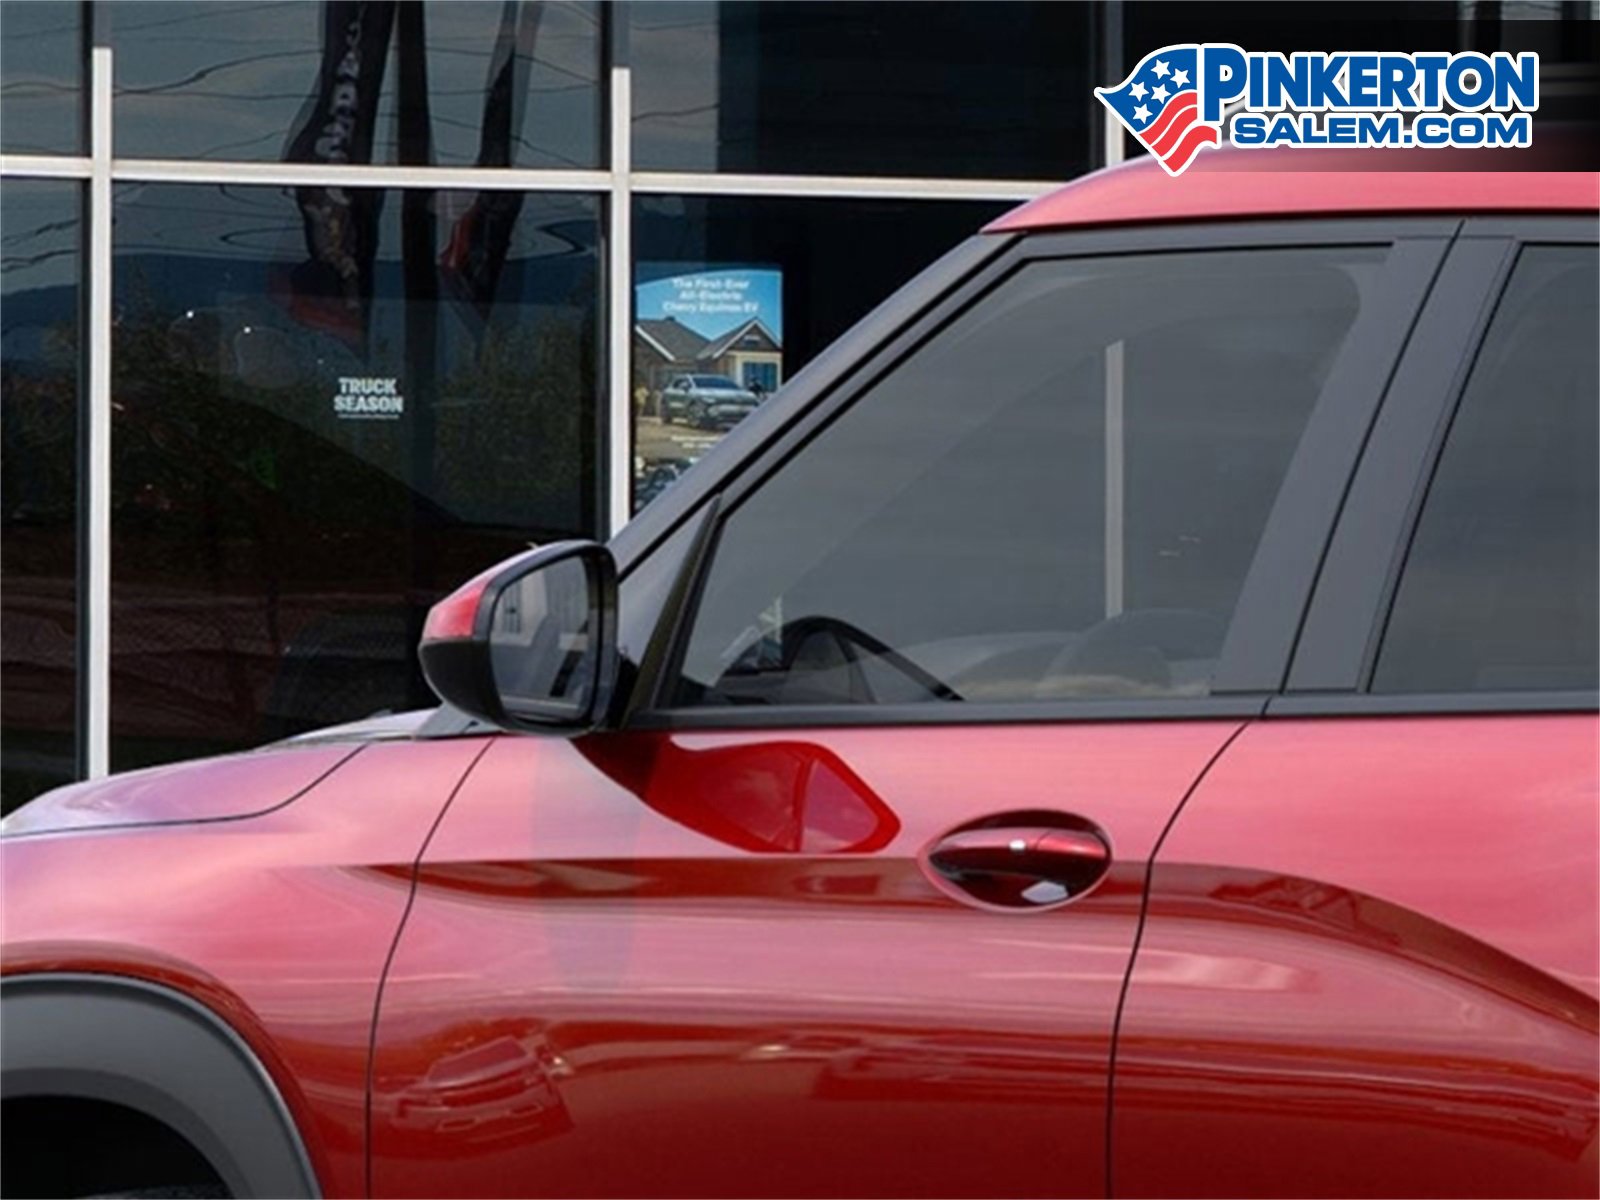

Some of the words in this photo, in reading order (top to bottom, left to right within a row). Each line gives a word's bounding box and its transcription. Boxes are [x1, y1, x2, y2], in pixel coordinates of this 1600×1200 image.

[672, 277, 693, 288] The
[744, 301, 760, 312] EV
[338, 376, 397, 394] TRUCK
[333, 395, 404, 413] SEASON
